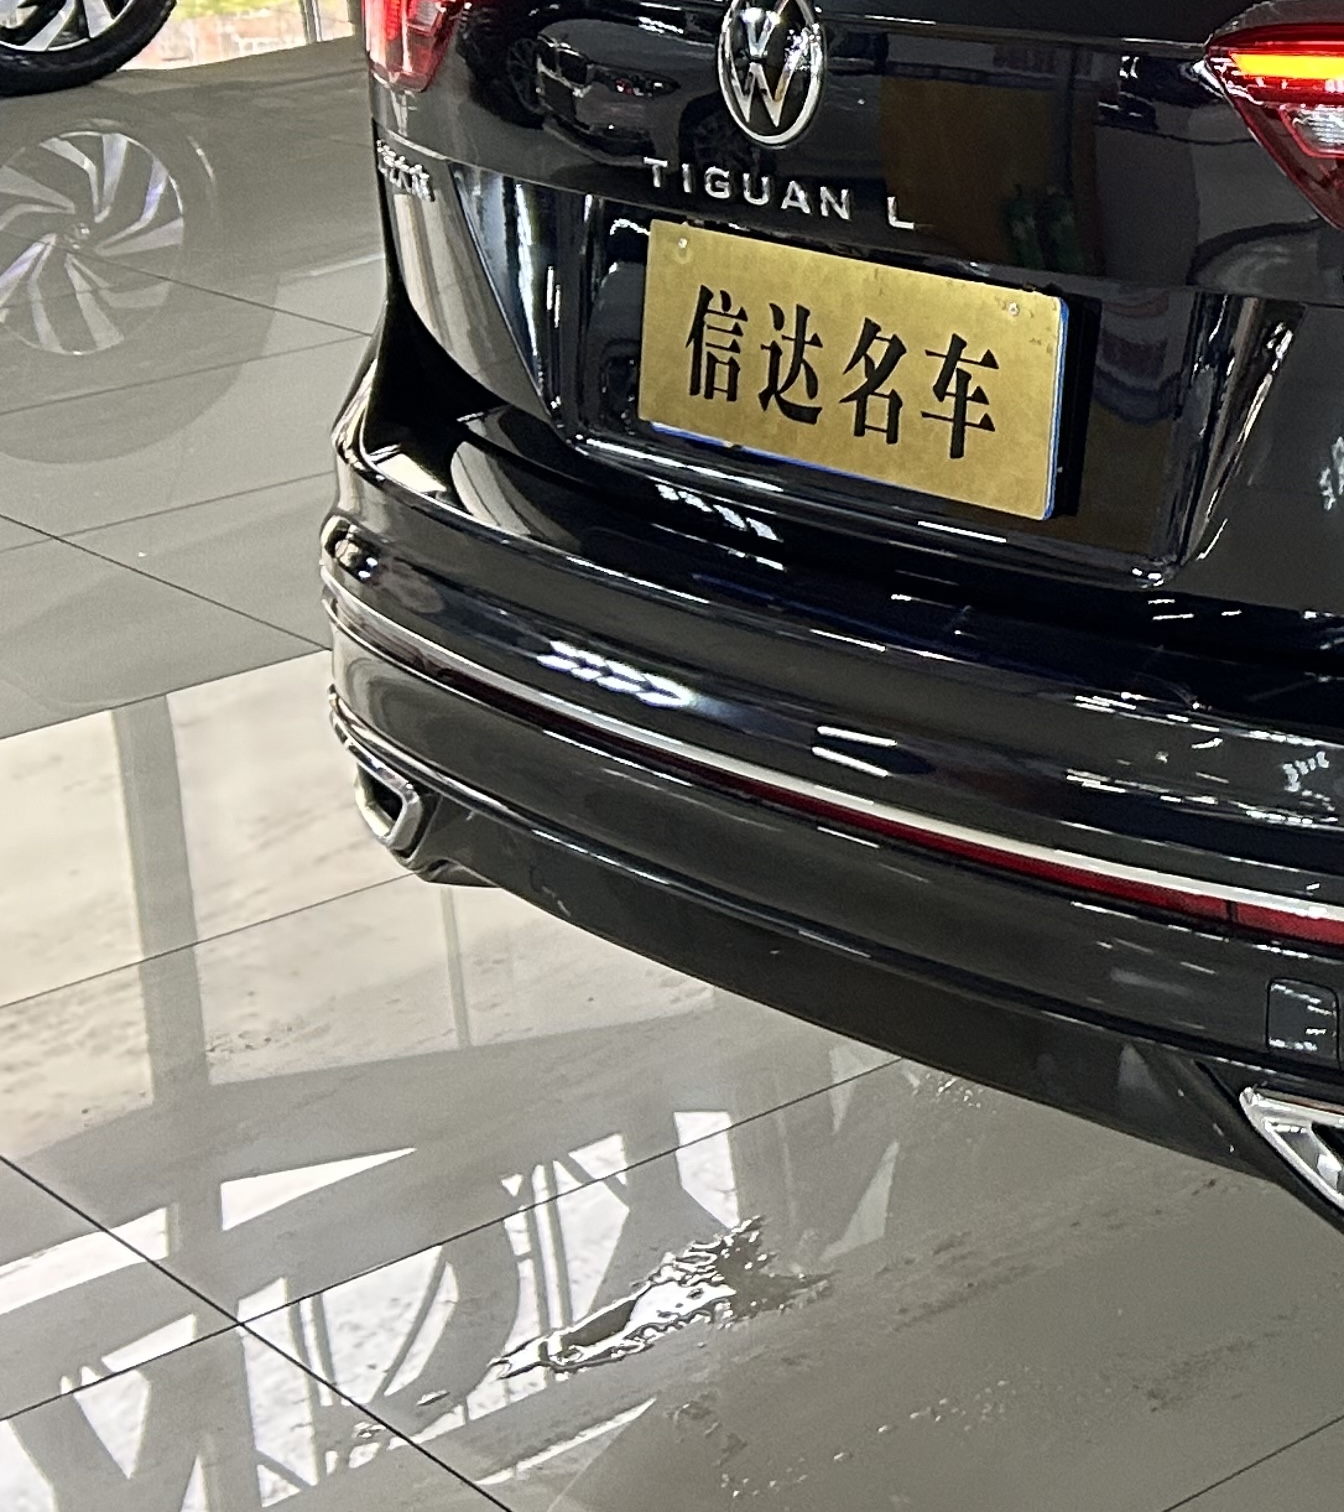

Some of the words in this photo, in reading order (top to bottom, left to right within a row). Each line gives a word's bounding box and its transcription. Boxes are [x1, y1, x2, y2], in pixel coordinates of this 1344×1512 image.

[643, 156, 853, 221] TIGUAN
[886, 196, 916, 231] L
[686, 284, 1000, 460] 信达名车
